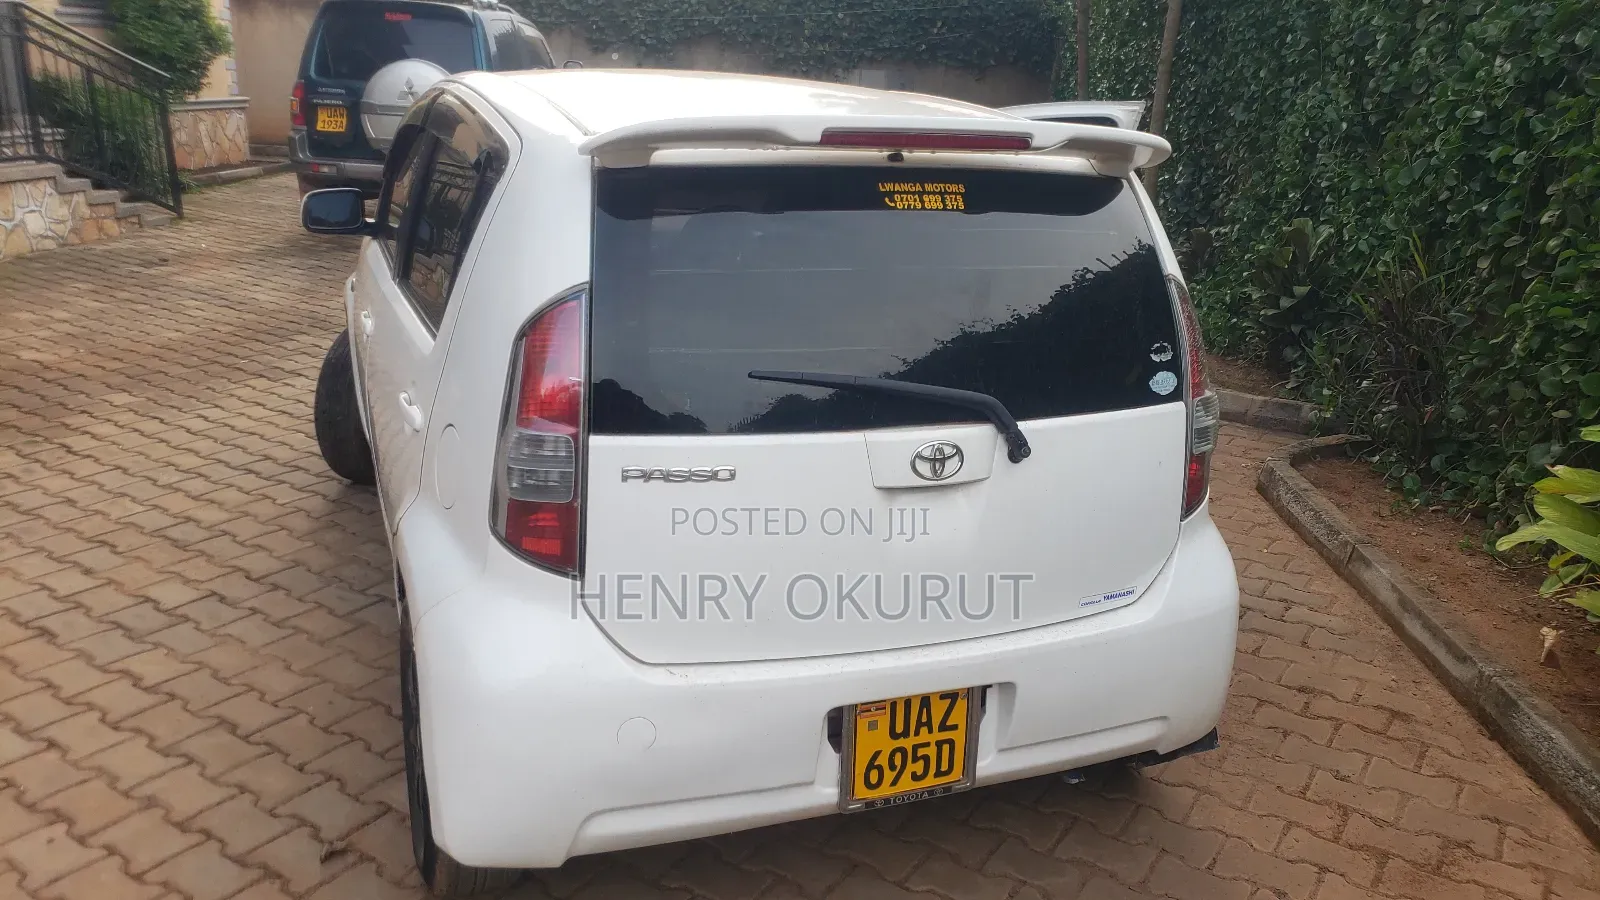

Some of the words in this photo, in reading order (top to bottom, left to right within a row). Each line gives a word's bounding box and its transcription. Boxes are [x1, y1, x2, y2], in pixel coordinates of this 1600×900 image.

[320, 119, 344, 130] 193A
[878, 182, 922, 192] LWANGA
[924, 183, 966, 193] MOTORS
[894, 194, 920, 202] 0701
[944, 194, 963, 203] 375
[896, 201, 922, 209] 0779
[946, 202, 965, 210] 375
[621, 465, 736, 483] PASSO
[1103, 589, 1135, 601] YAMANASHI
[888, 691, 960, 741] UAZ
[863, 738, 956, 791] 695D
[889, 791, 929, 804] TOYOTA
